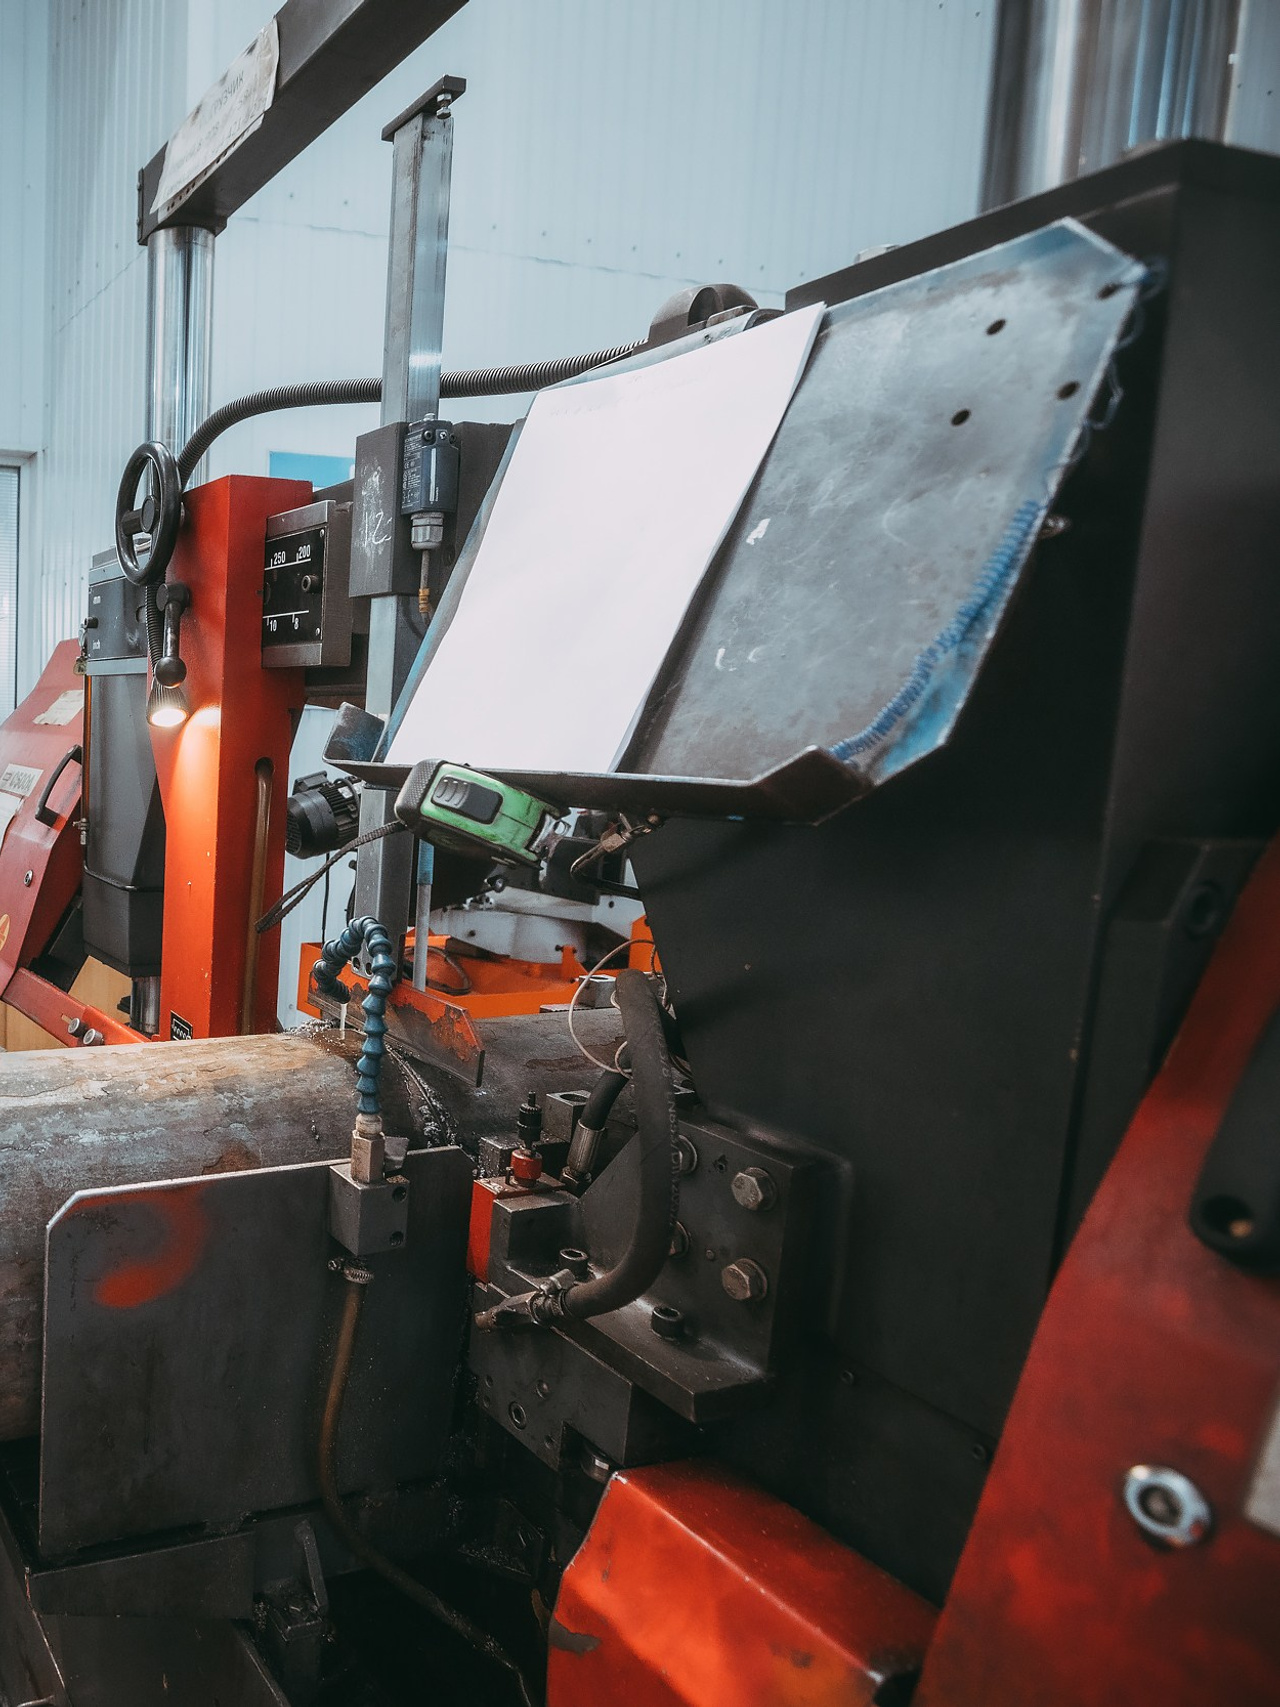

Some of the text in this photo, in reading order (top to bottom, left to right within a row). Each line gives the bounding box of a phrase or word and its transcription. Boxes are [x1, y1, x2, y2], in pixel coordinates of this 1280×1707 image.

[273, 544, 311, 565] 250 200
[269, 617, 300, 632] 10 8
